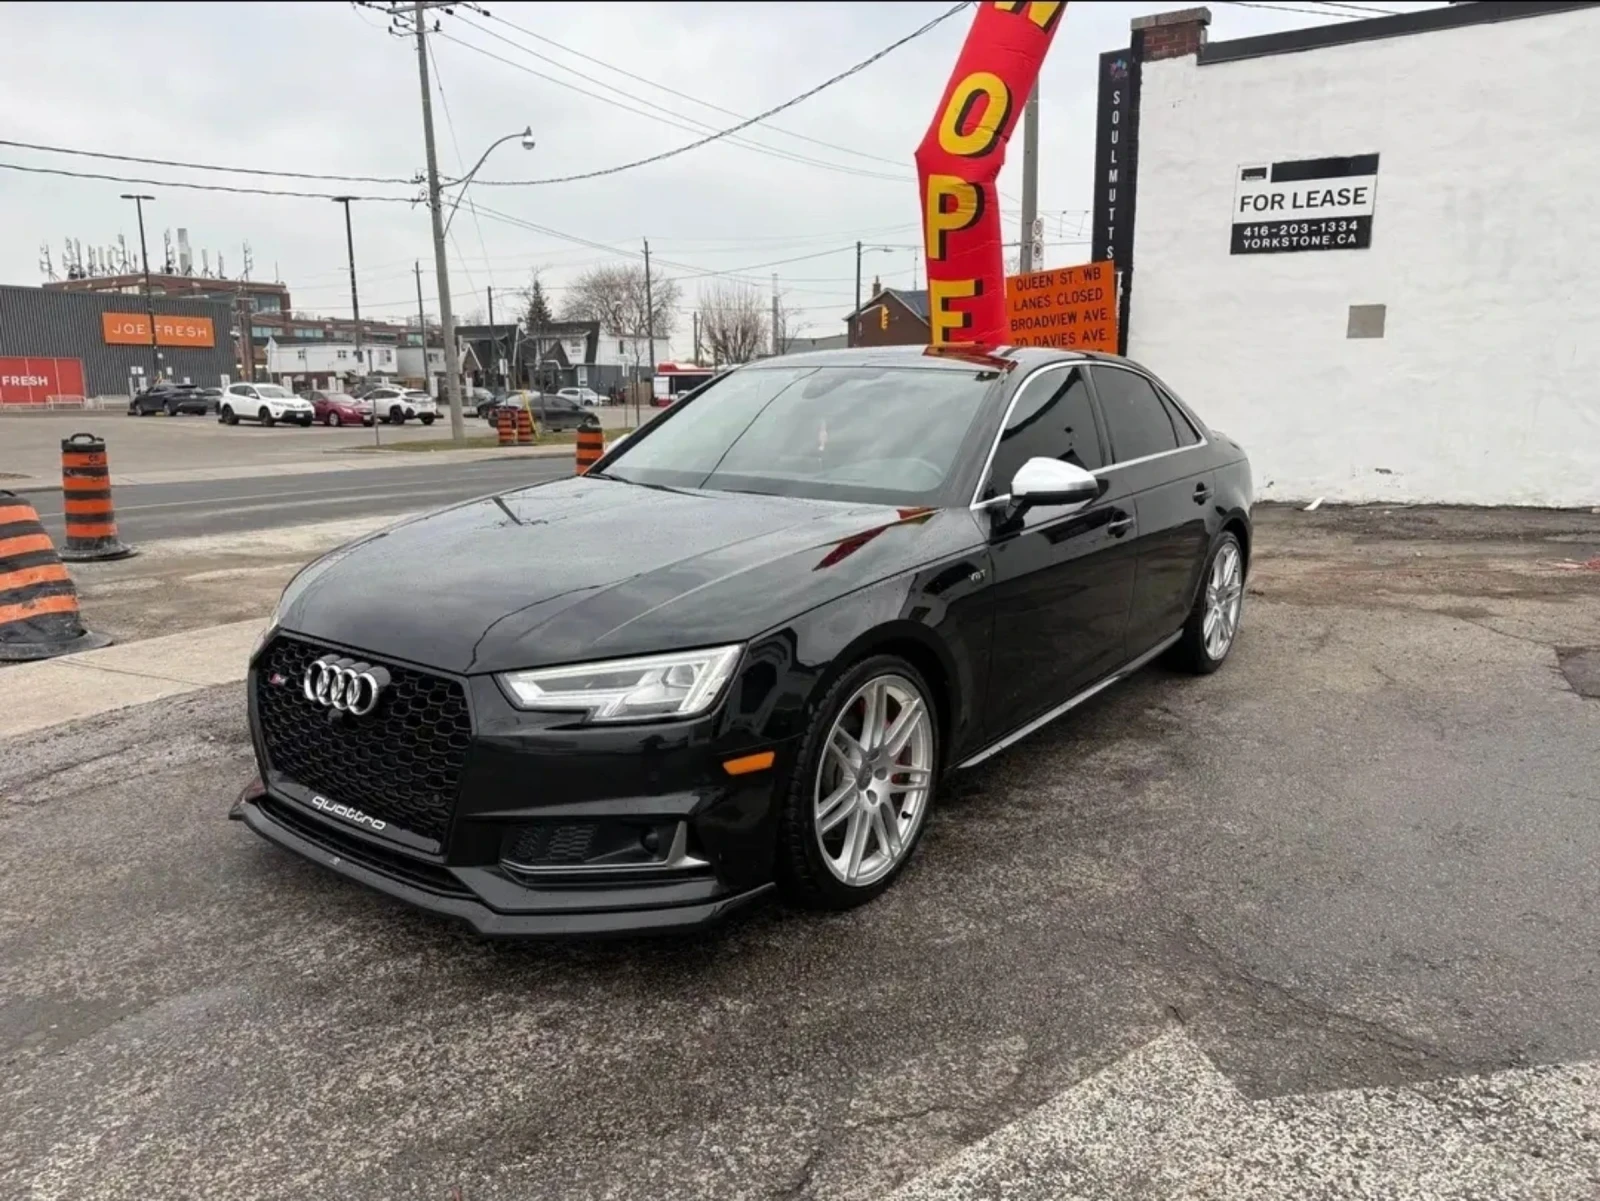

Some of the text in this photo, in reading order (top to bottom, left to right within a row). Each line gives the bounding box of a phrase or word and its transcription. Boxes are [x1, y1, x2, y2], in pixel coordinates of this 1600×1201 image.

[1106, 90, 1121, 259] SOULMUTTS
[1240, 187, 1368, 212] FOR LEASE
[1243, 220, 1358, 236] 416-203-1334
[1243, 233, 1357, 248] YORKSTONE.CA
[1016, 274, 1054, 291] QUEEN
[1083, 267, 1101, 280] WB
[1014, 288, 1103, 312] LANES CLOSED
[112, 323, 207, 338] JOE FRESH
[1011, 308, 1111, 331] BROADVIEW AVE.
[1034, 332, 1076, 347] DAVIES
[1082, 328, 1110, 342] AVE.
[1, 375, 49, 387] FRESH
[312, 795, 386, 830] quattro
